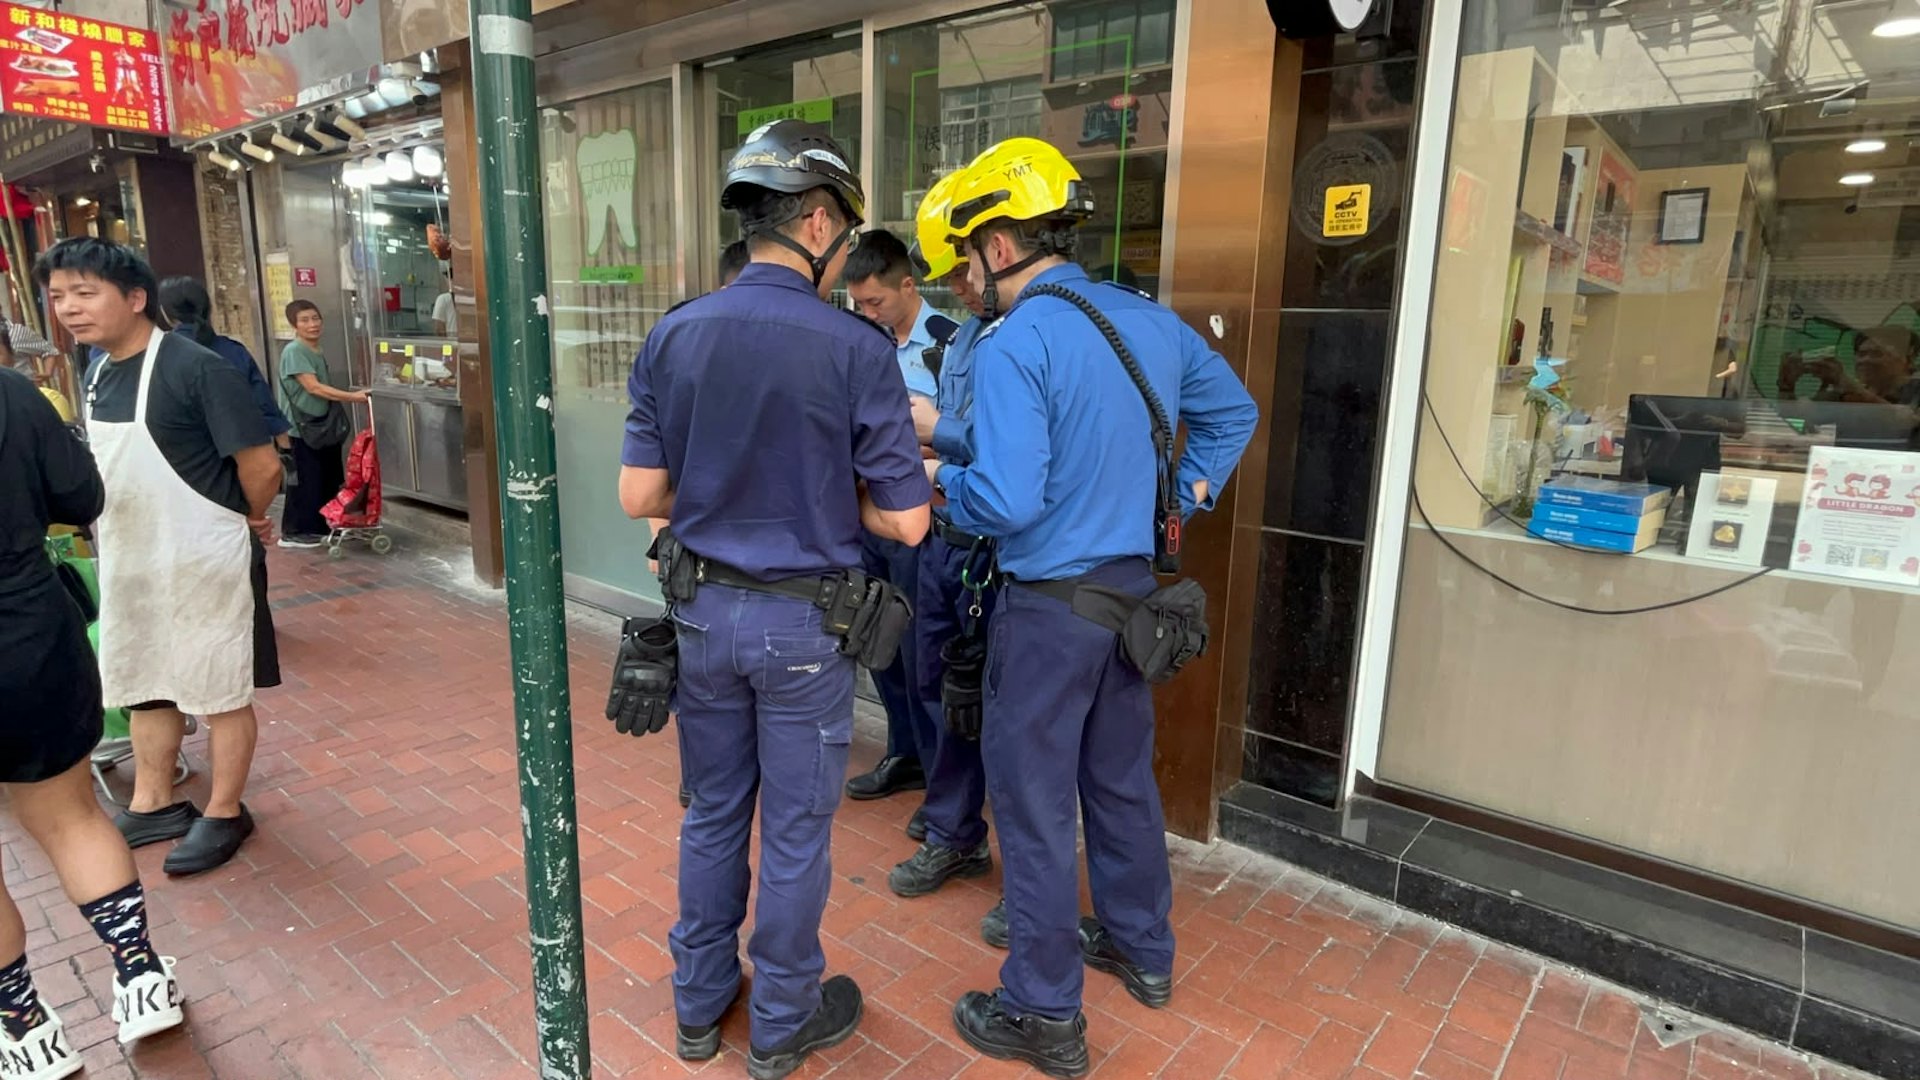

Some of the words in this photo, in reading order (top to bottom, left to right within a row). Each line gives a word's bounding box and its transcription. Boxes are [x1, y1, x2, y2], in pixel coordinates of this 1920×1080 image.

[1003, 162, 1033, 181] YMT
[1826, 499, 1857, 509] LITTLE
[1859, 501, 1904, 512] DRAGON
